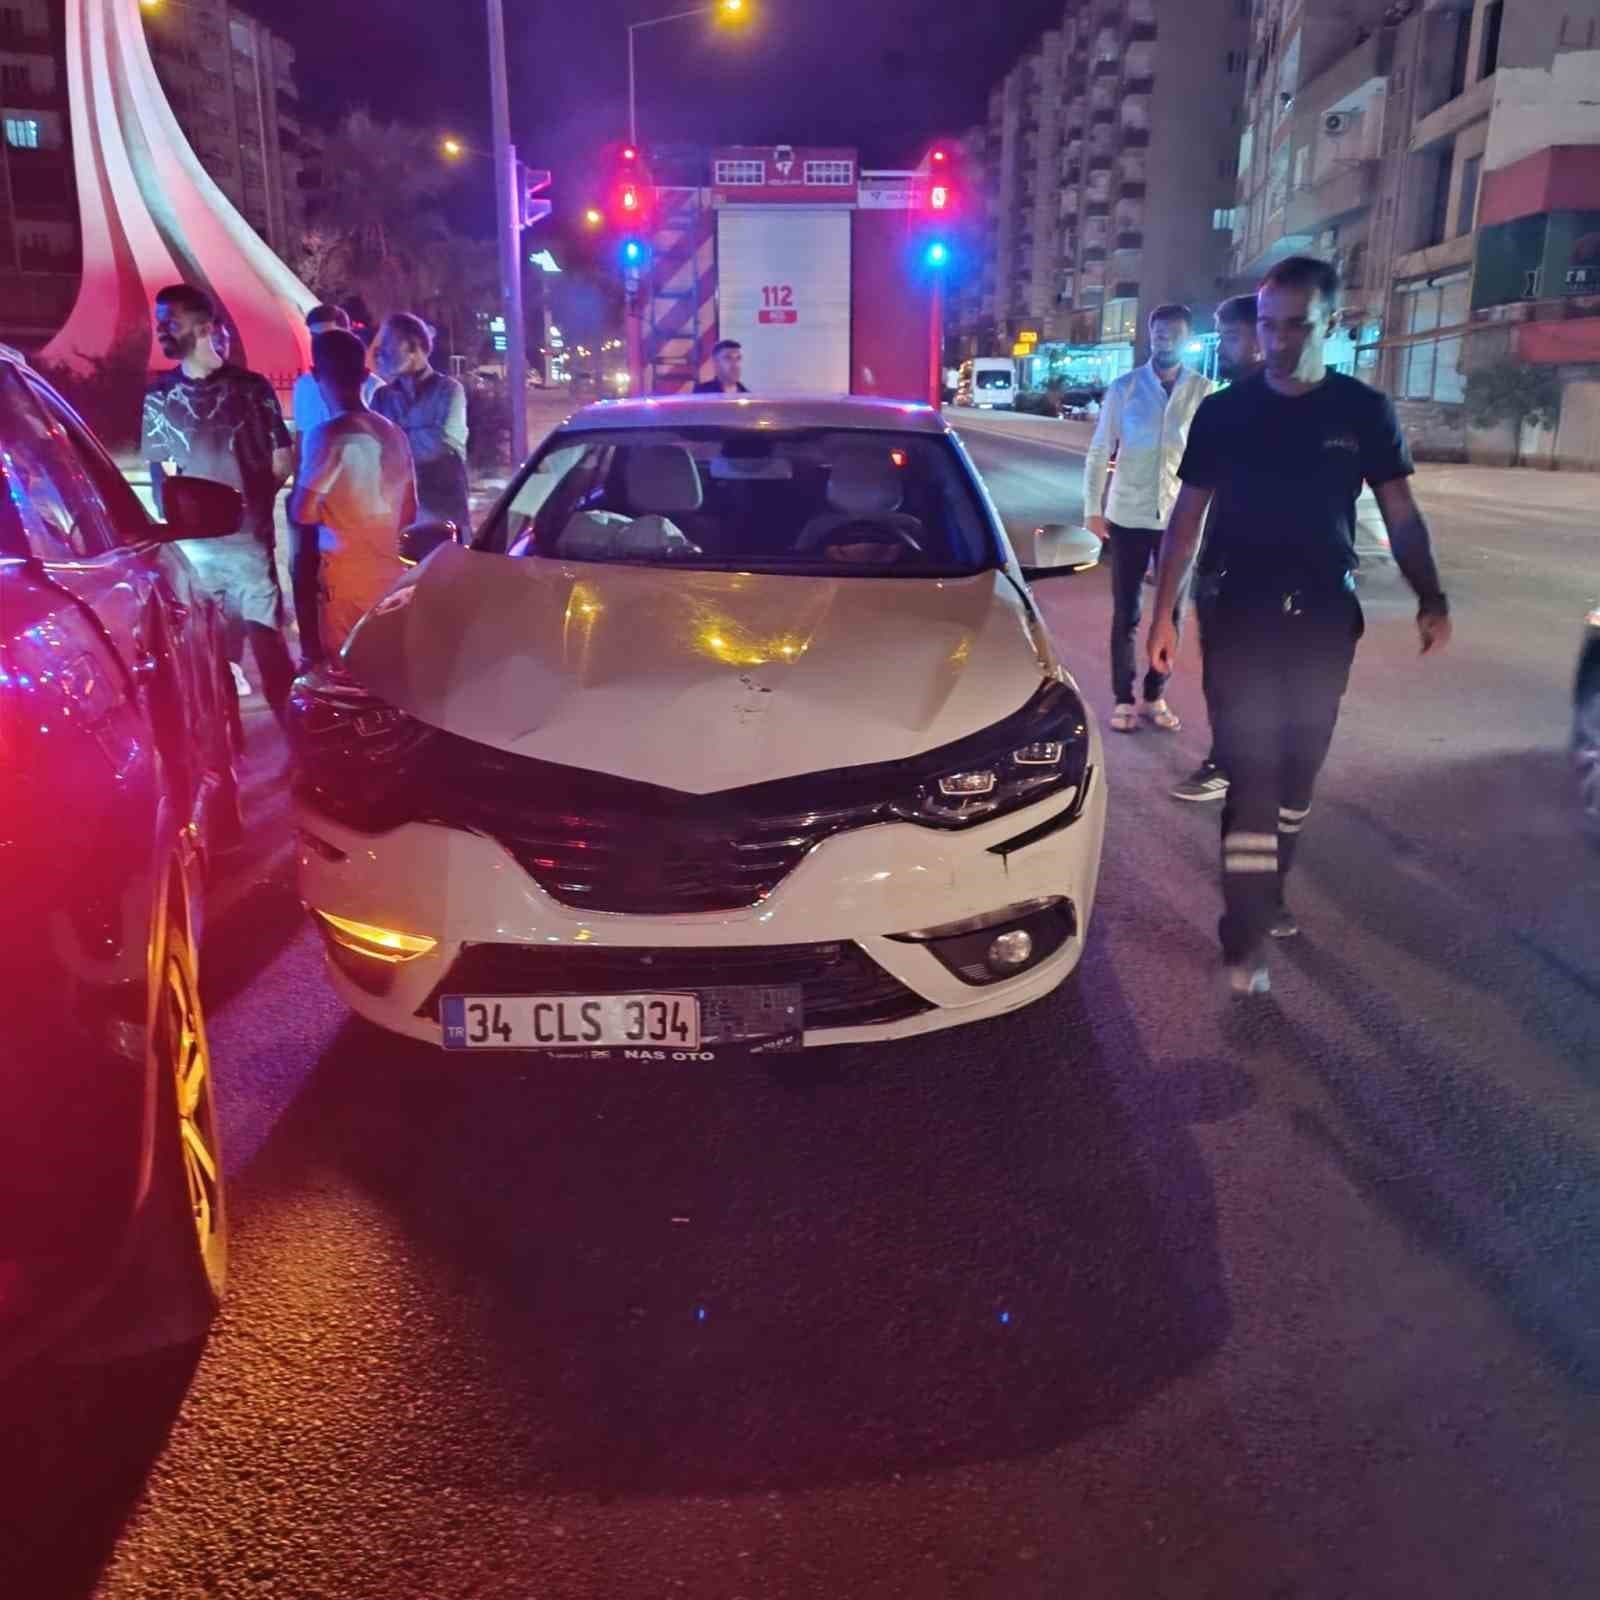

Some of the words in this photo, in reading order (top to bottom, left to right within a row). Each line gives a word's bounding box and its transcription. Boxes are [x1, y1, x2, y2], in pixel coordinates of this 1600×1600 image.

[761, 285, 793, 307] 112
[468, 1003, 512, 1042] 34
[533, 1002, 602, 1042] CLS
[624, 1001, 689, 1042] 334
[448, 1026, 465, 1038] TR
[671, 1051, 716, 1061] OTO
